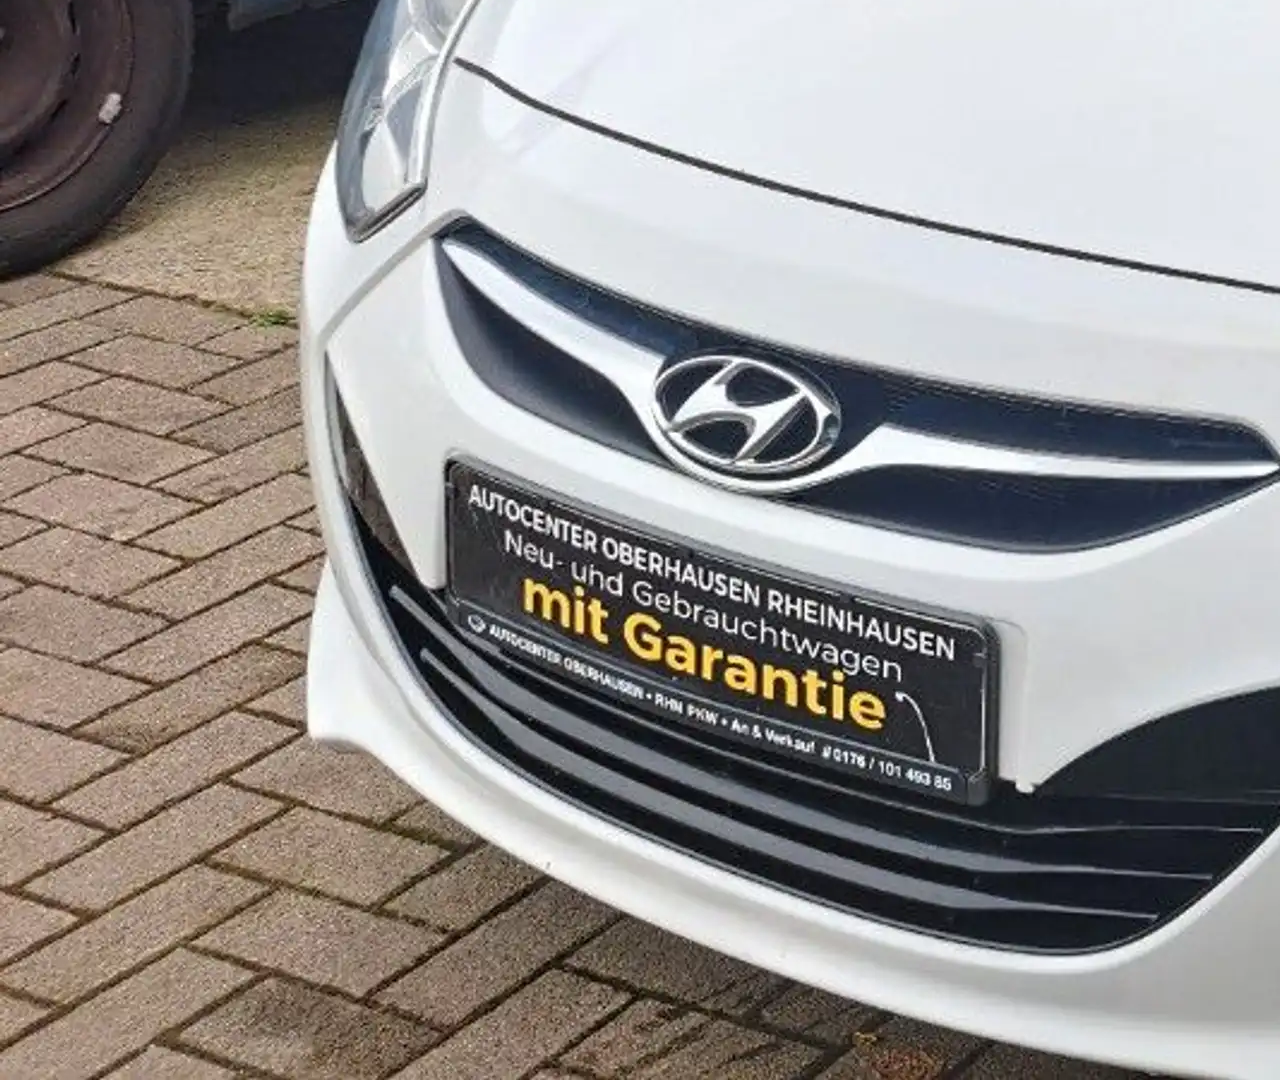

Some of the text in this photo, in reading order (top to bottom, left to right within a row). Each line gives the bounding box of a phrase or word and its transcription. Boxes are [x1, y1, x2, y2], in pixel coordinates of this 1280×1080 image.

[468, 485, 956, 661] AUTOCENTER OBERHAUSEN RHEINHAUSEN
[503, 529, 564, 570] Neu-
[632, 580, 903, 682] Gebrauchtwagen
[488, 624, 563, 665] AUTOCENTER
[563, 656, 645, 700] OBERHAUSEN
[686, 704, 719, 726] PKW
[730, 718, 750, 735] An
[765, 727, 816, 754] Verkauf
[879, 760, 902, 778] 101
[934, 776, 952, 792] 85
[522, 577, 887, 731] mit Garantie
